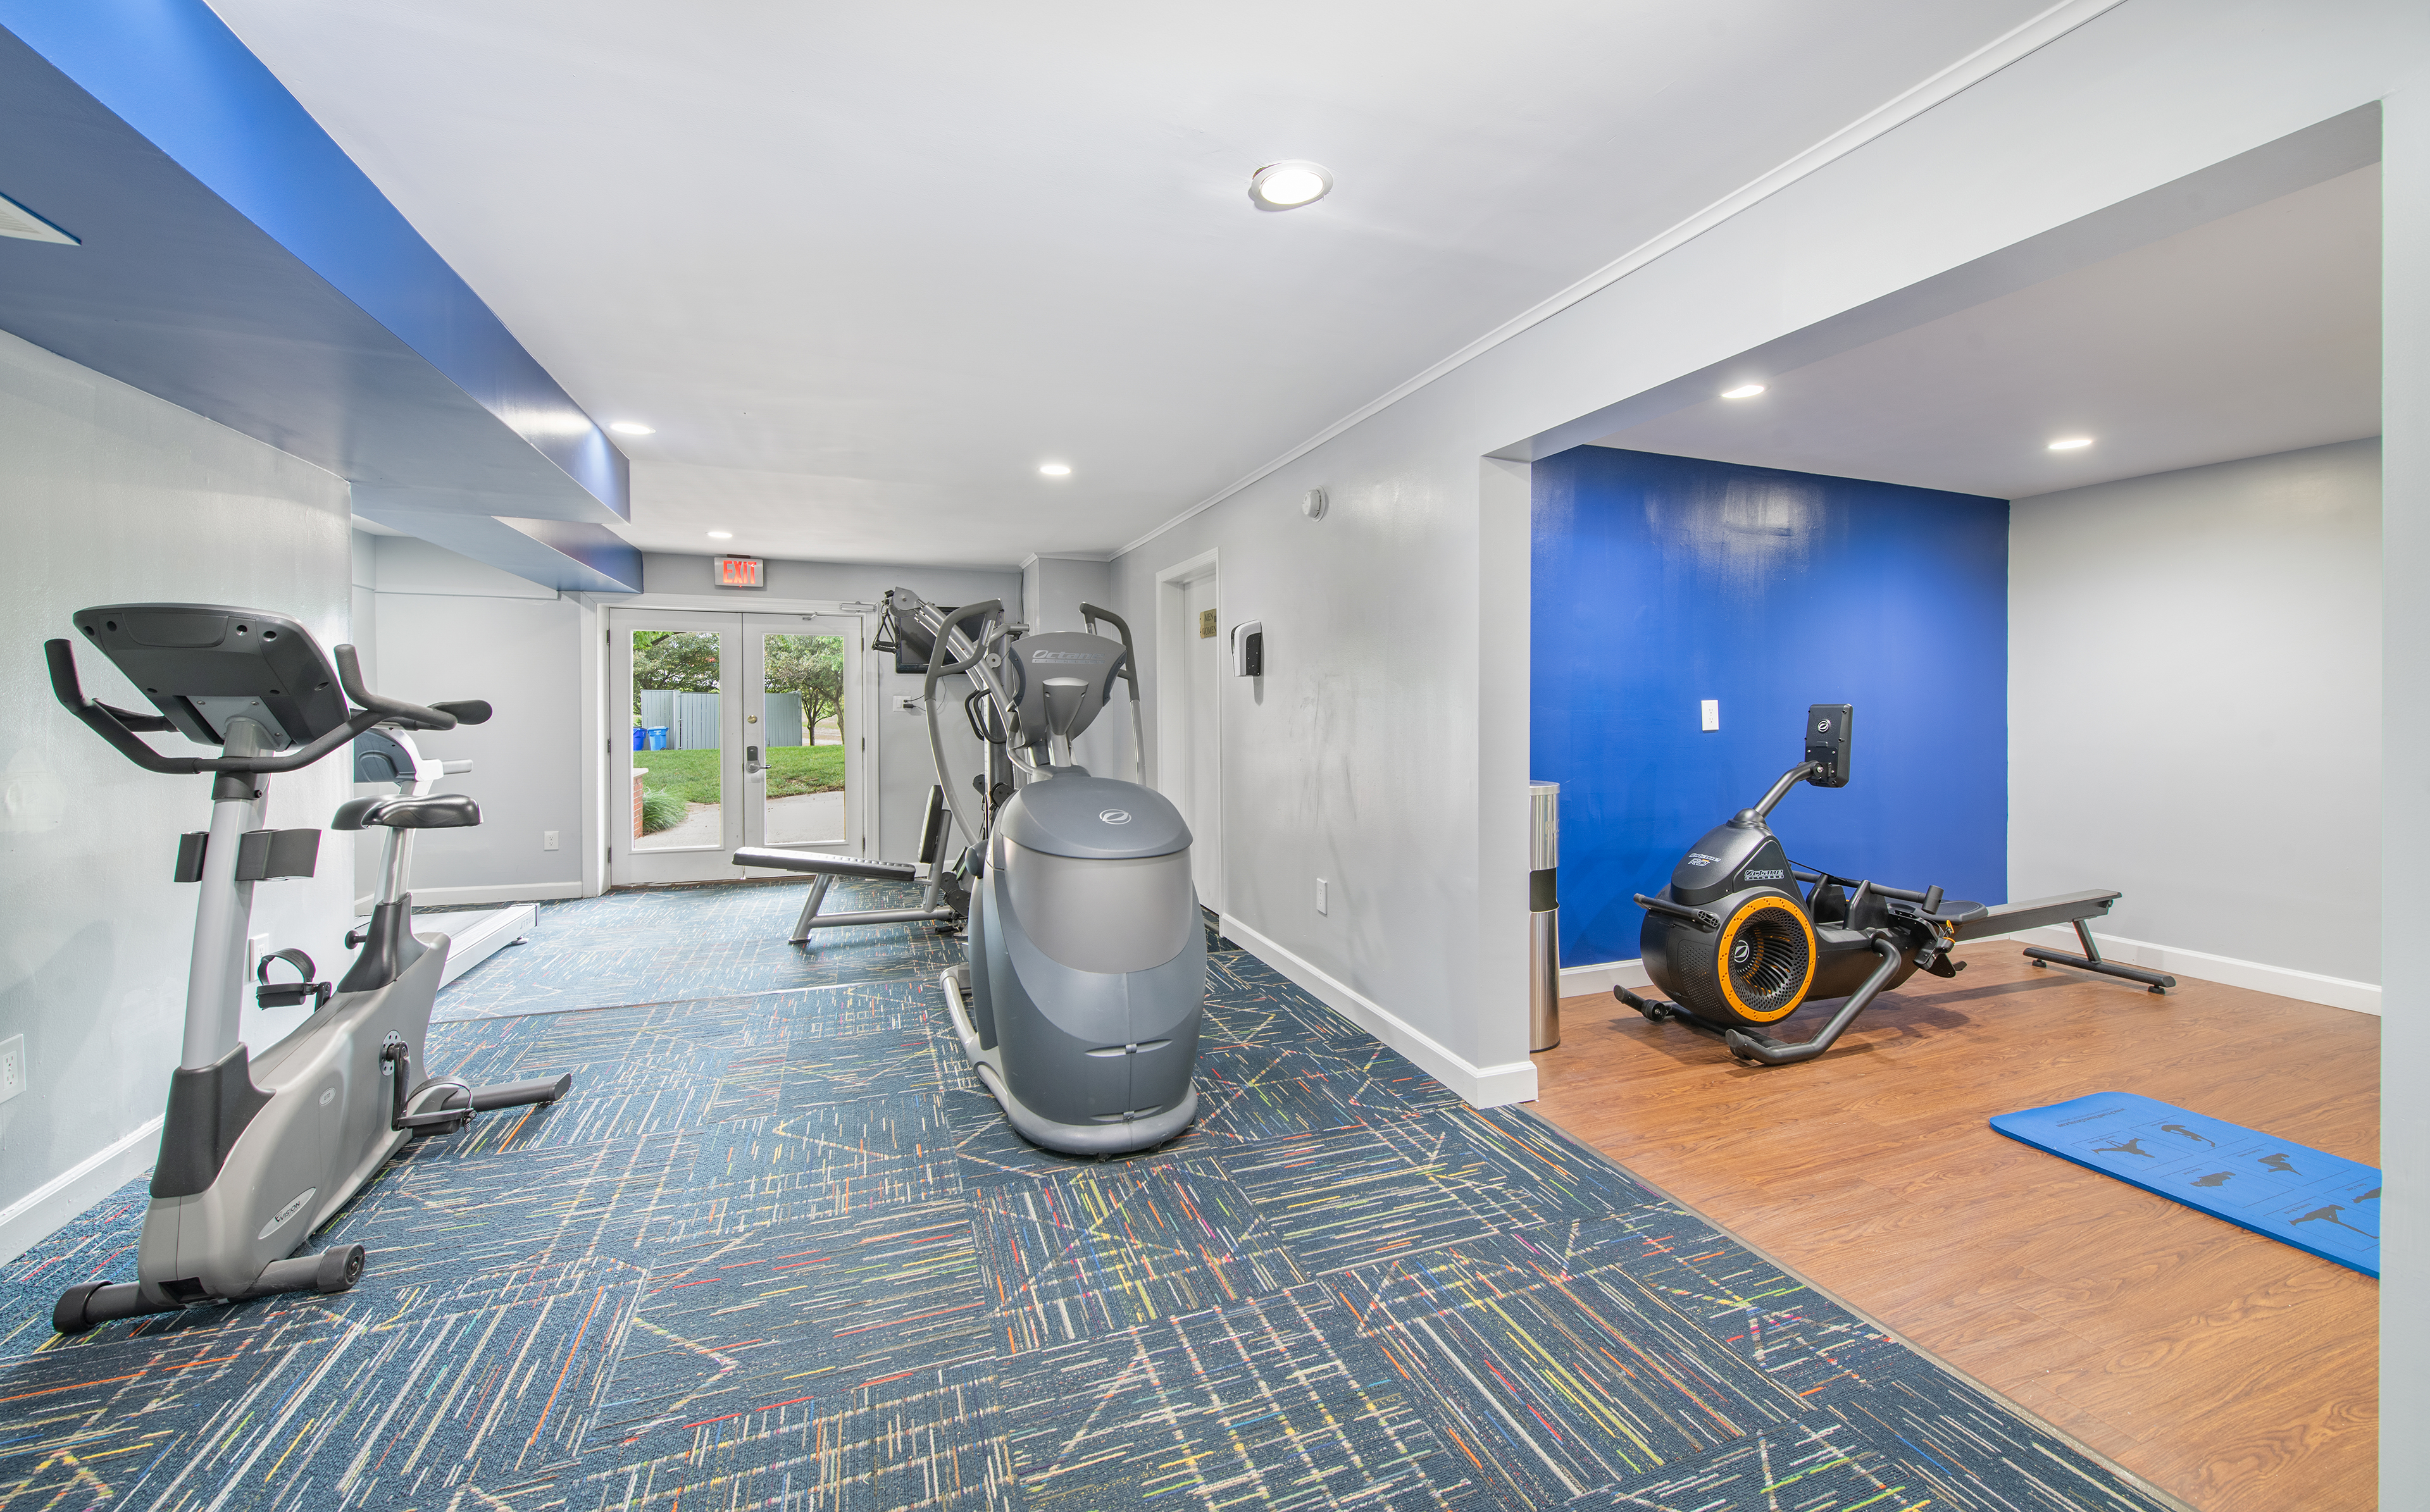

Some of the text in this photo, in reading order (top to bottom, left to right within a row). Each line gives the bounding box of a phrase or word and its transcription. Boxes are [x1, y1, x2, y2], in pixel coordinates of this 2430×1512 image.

[723, 560, 757, 584] EXIT
[1204, 612, 1214, 622] MEN
[1032, 650, 1105, 659] Octane
